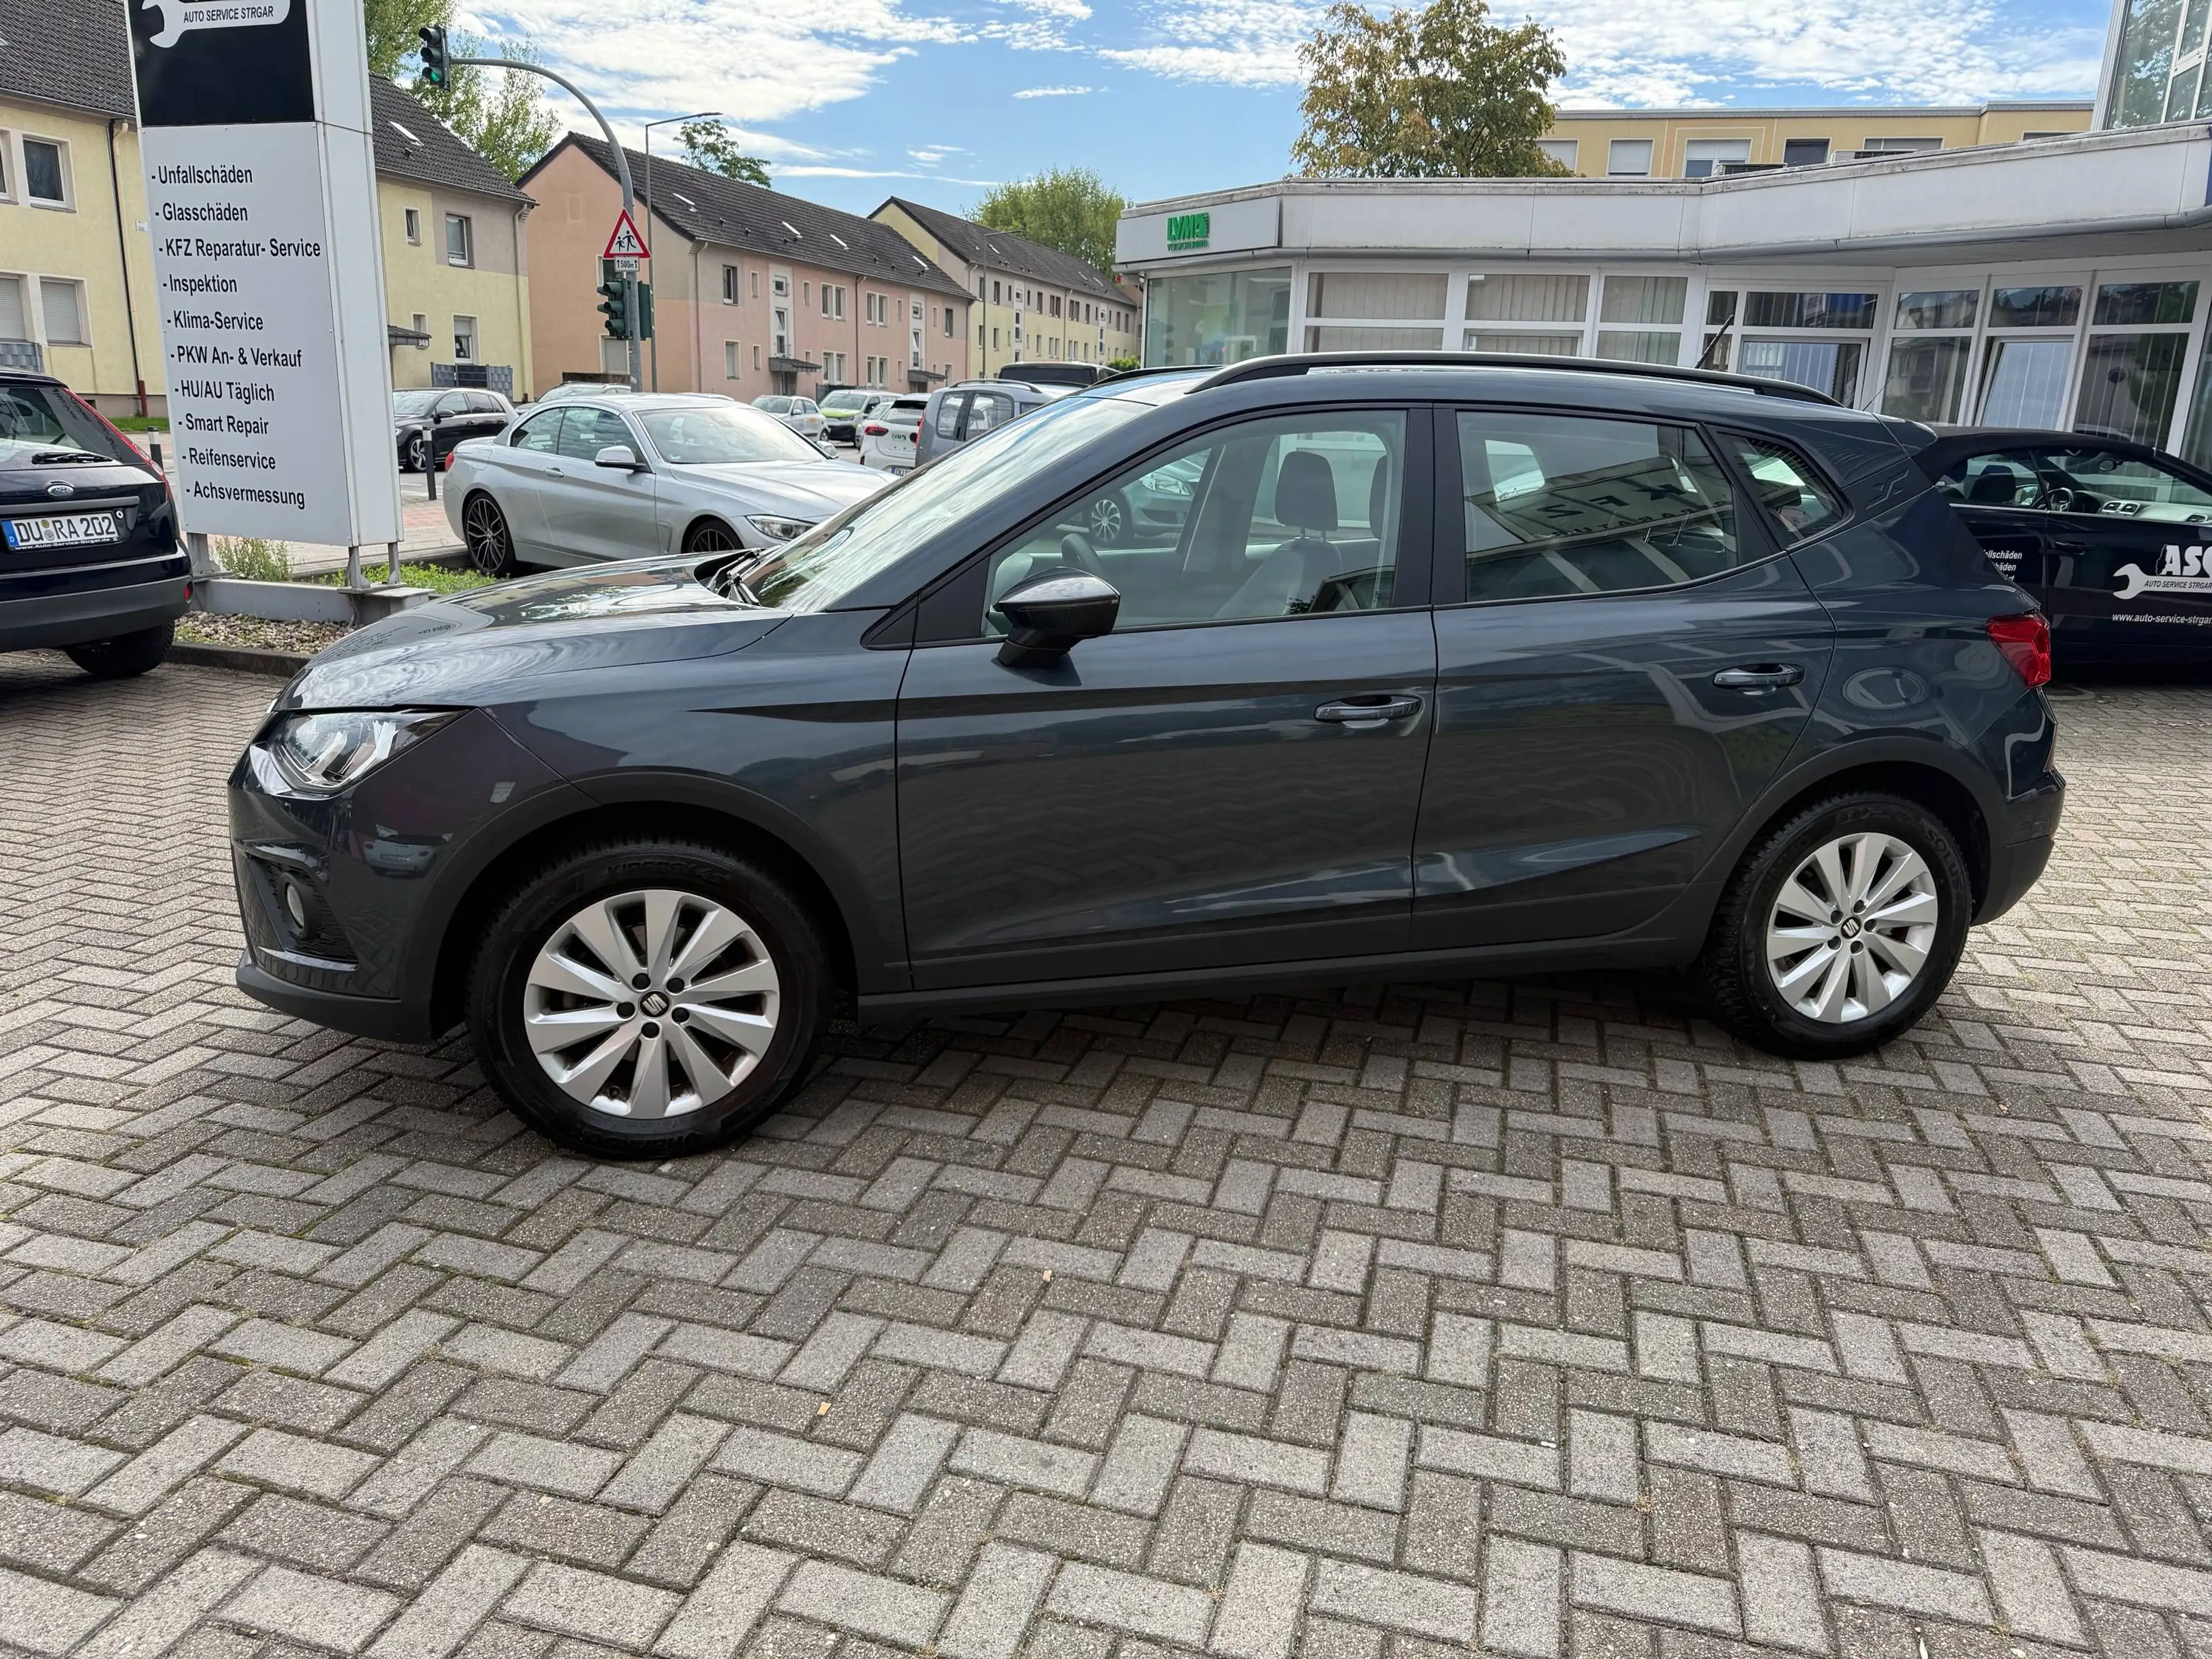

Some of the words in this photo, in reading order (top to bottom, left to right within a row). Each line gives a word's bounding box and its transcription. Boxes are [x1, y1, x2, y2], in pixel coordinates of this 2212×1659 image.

[184, 12, 204, 23] AUTO
[206, 8, 239, 21] SERVICE
[241, 6, 274, 19] STRGAR
[158, 164, 253, 184] Unfallschäden
[162, 202, 248, 222] Glasschäden
[165, 238, 192, 257] KFZ
[196, 237, 266, 261] Reparatur-
[270, 237, 321, 258] Service
[169, 273, 237, 296] Inspektion
[173, 310, 263, 330] Klima-Service
[177, 345, 207, 364] PKW
[211, 346, 233, 364] An-
[238, 347, 248, 365] &
[250, 347, 302, 368] Verkauf
[181, 380, 223, 399] HU/AU
[226, 381, 275, 404] Täglich
[185, 412, 224, 433] Smart
[227, 415, 269, 437] Repair
[188, 447, 276, 469] Reifenservice
[194, 480, 305, 509] Achsvermessung
[14, 520, 44, 543] DU
[54, 518, 80, 540] RA
[80, 516, 116, 538] 202
[2162, 581, 2187, 589] SERVICE
[2188, 582, 2212, 590] STRGAR
